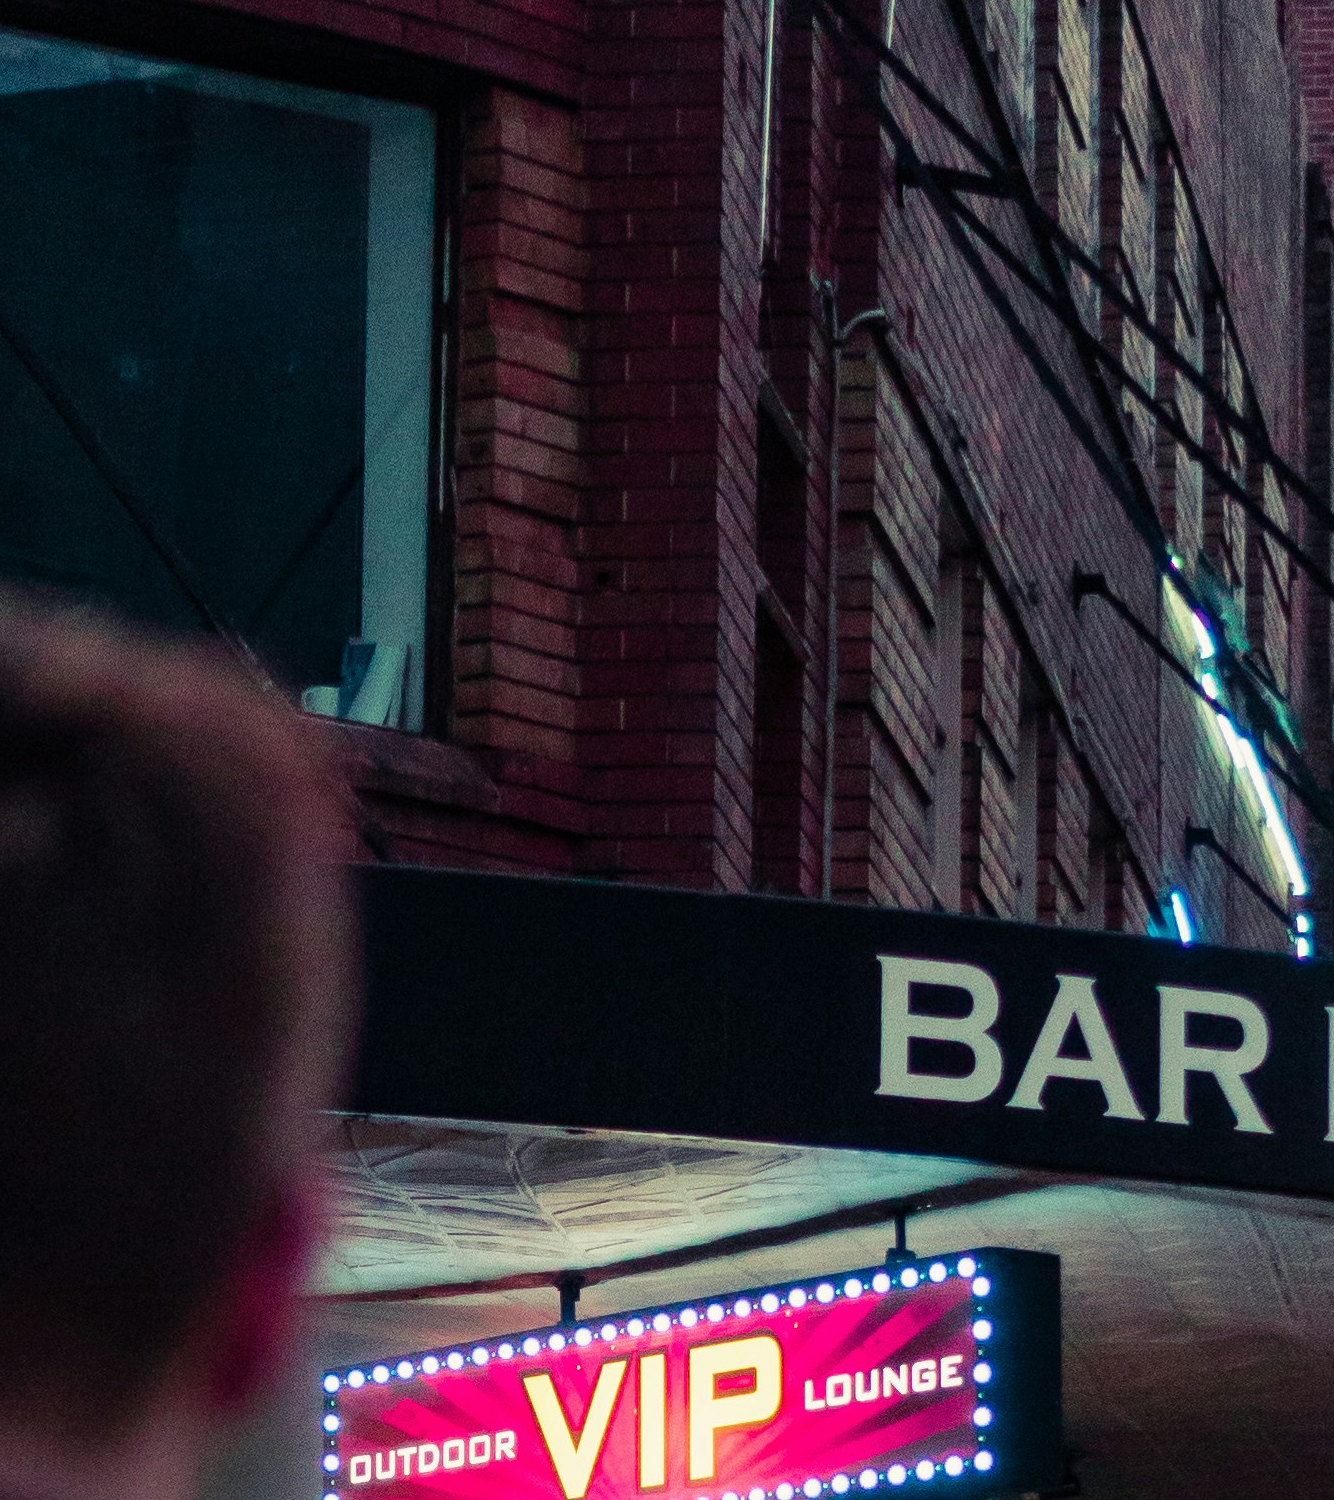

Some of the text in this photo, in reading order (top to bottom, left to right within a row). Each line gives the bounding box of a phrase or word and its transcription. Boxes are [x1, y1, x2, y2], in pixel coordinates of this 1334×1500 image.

[876, 955, 1273, 1135] BAR
[350, 1333, 964, 1500] OUTDOOR VIP LOUNGE
